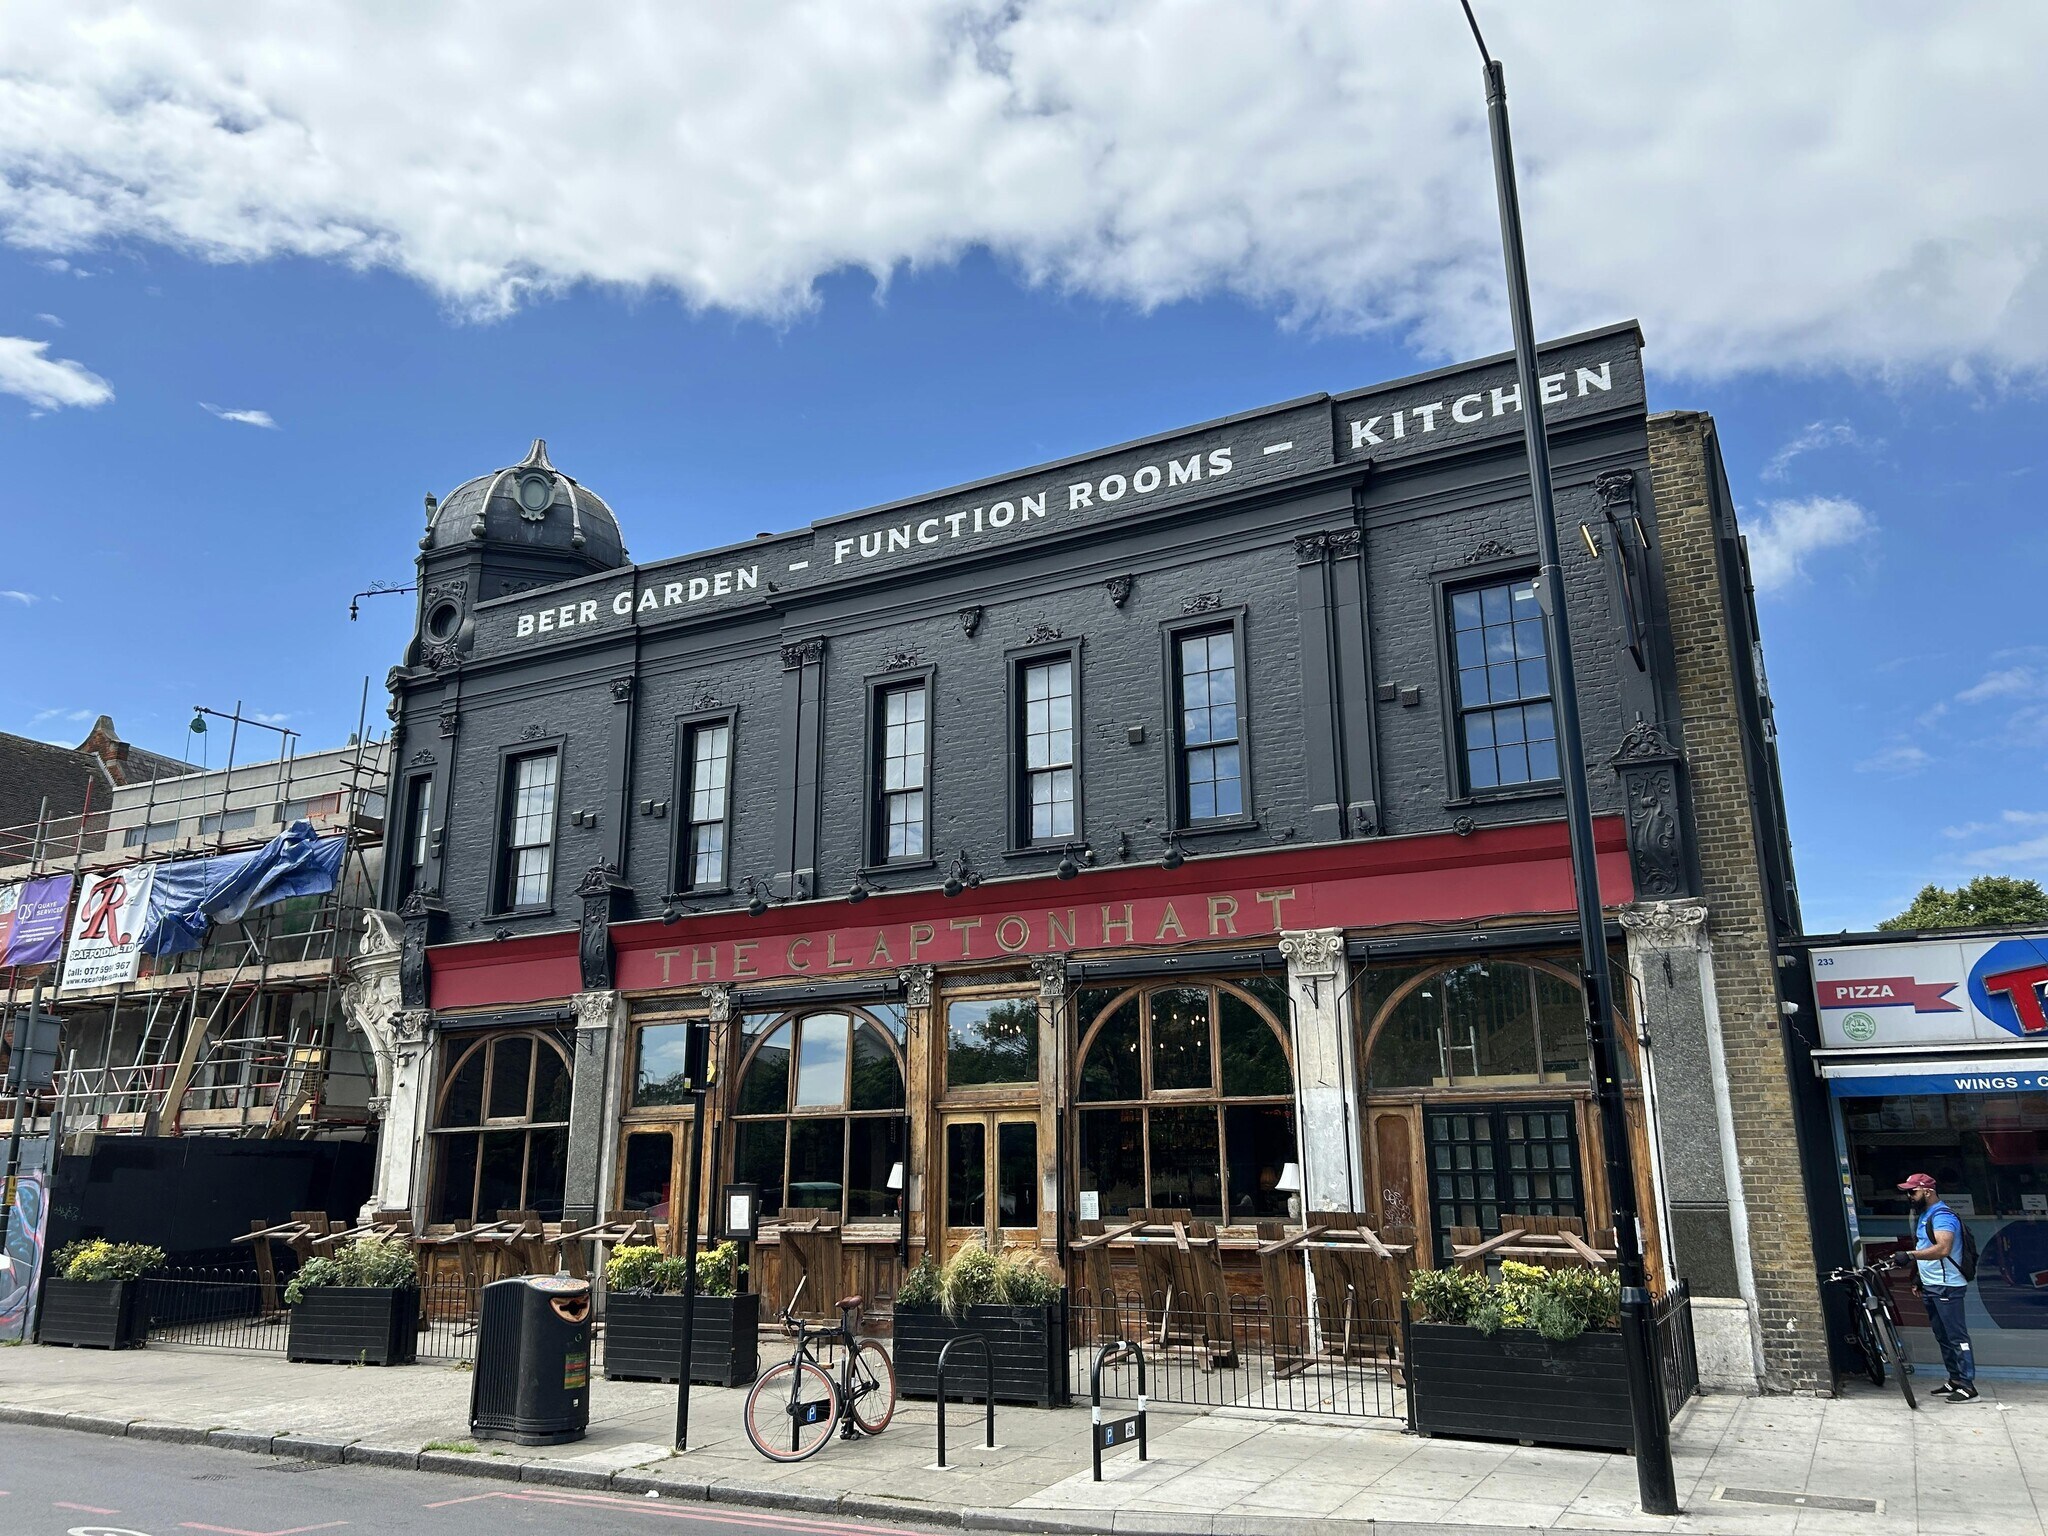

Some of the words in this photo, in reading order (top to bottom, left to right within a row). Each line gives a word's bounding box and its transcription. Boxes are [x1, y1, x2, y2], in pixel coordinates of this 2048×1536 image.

[516, 599, 598, 637] BEER
[612, 565, 759, 615] GARDEN
[833, 491, 1047, 565] FUNCTION
[1068, 446, 1233, 511] ROOMS
[1350, 361, 1612, 450] KITCHEN
[36, 907, 64, 916] SERVICES
[654, 941, 759, 983] THE
[785, 908, 1076, 971] CLAPTON
[1100, 887, 1296, 944] HART
[69, 945, 119, 961] SCAFFOLDIN
[1817, 958, 1834, 966] 233
[1836, 984, 1894, 999] PIZZA
[1954, 1077, 2019, 1090] WINGS
